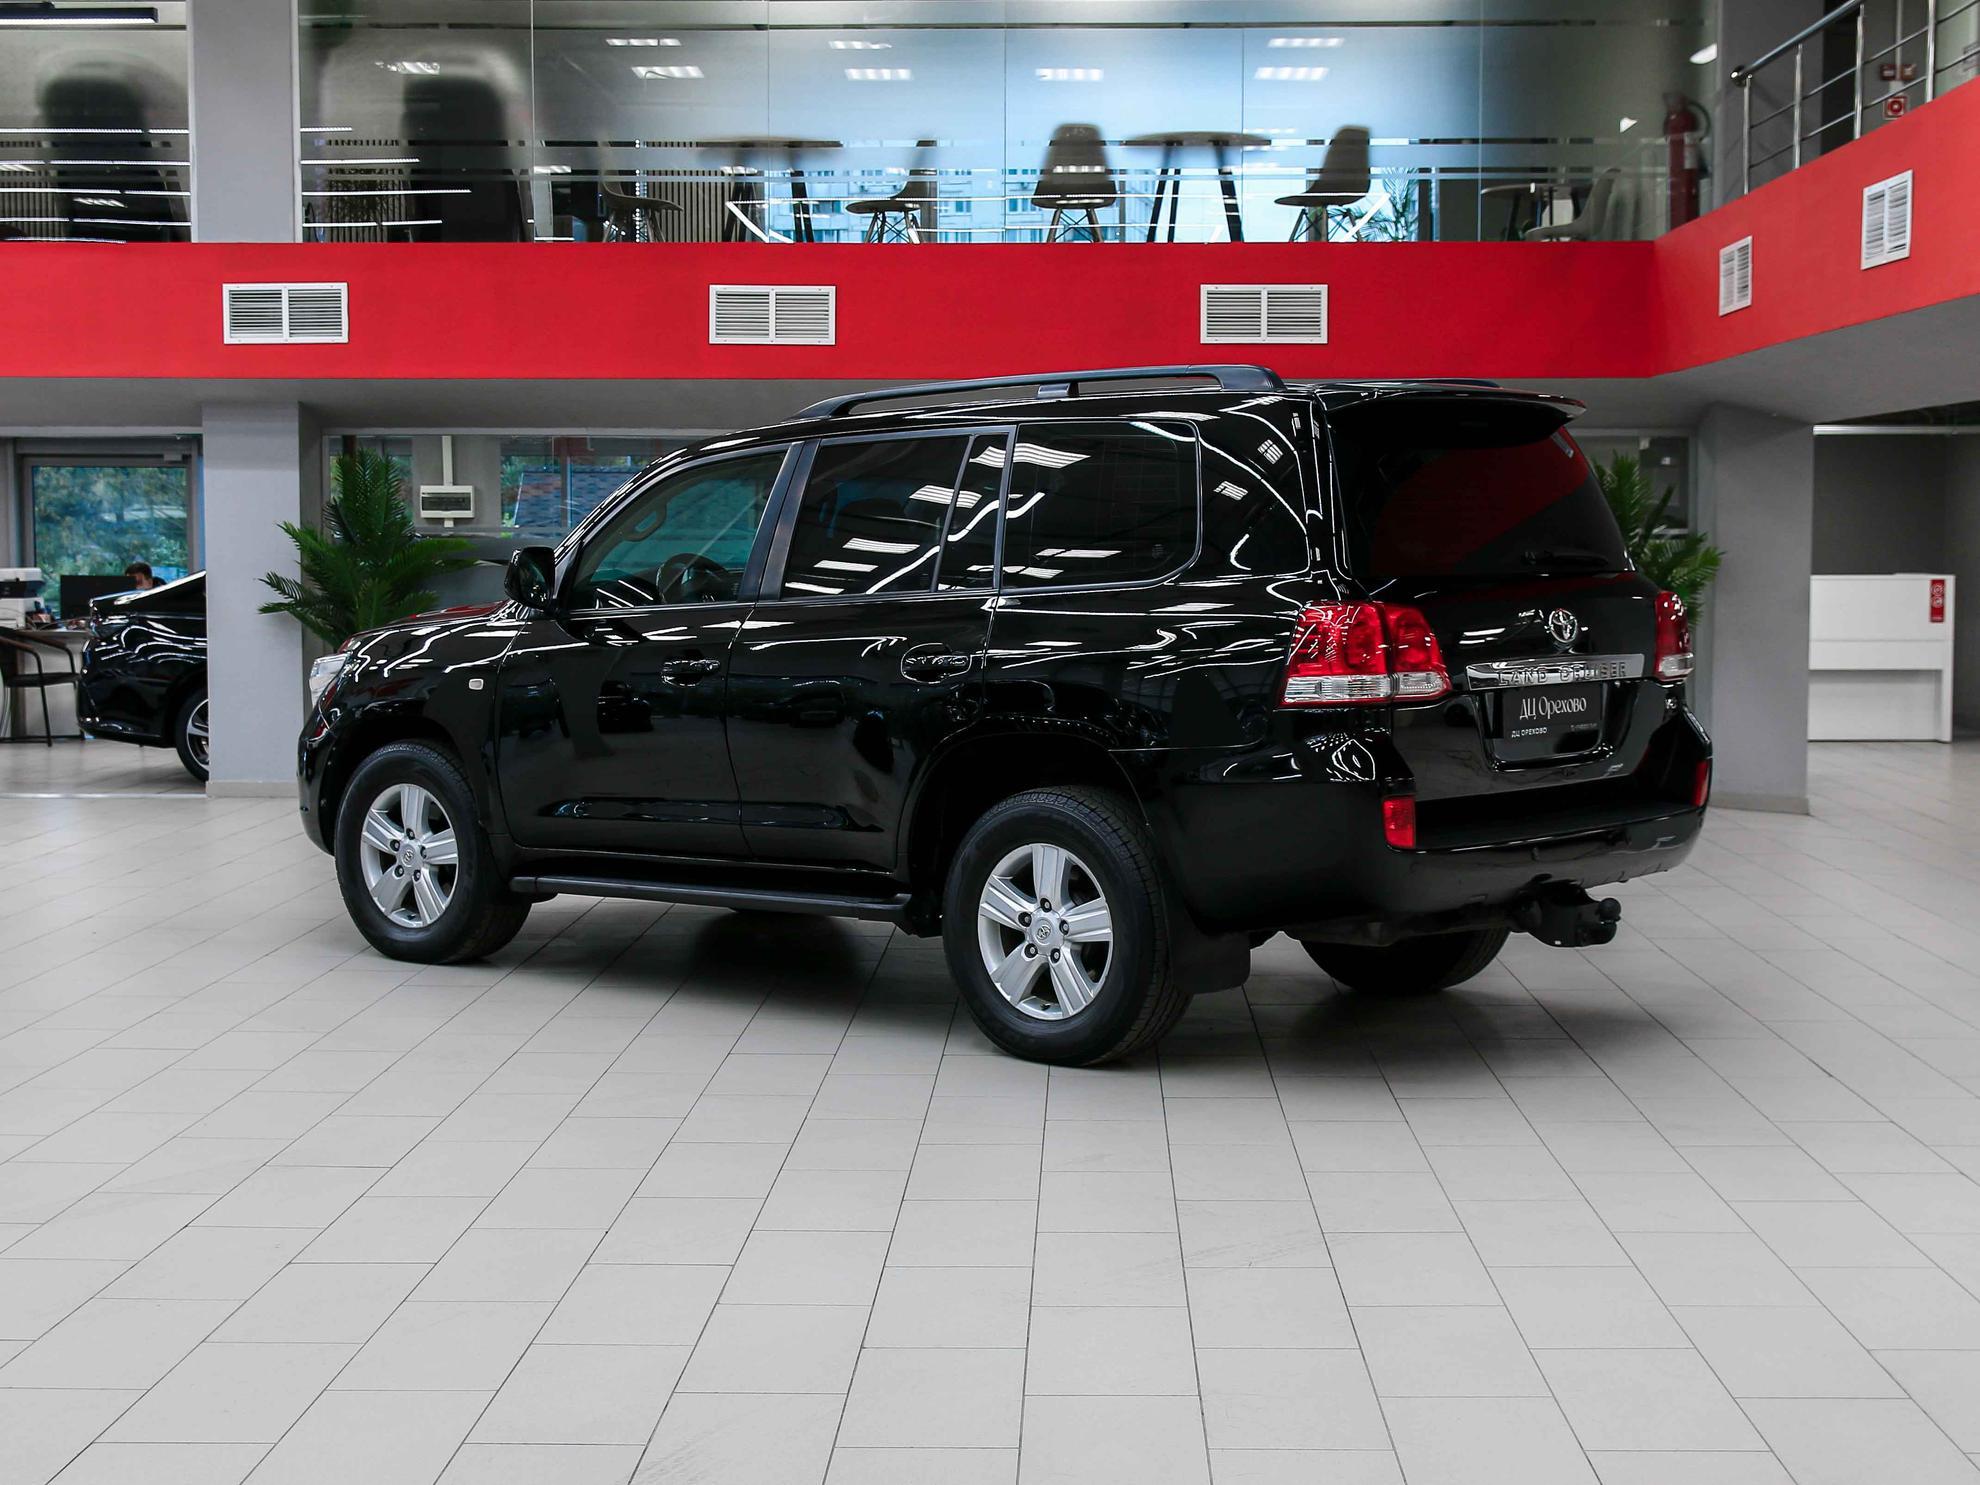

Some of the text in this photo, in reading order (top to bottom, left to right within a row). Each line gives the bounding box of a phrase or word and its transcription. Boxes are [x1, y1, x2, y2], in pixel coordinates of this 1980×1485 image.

[1498, 661, 1626, 686] LAND CRUISER
[1519, 696, 1587, 720] ДЦ Орехово
[1521, 727, 1548, 736] ОРЕХОВО
